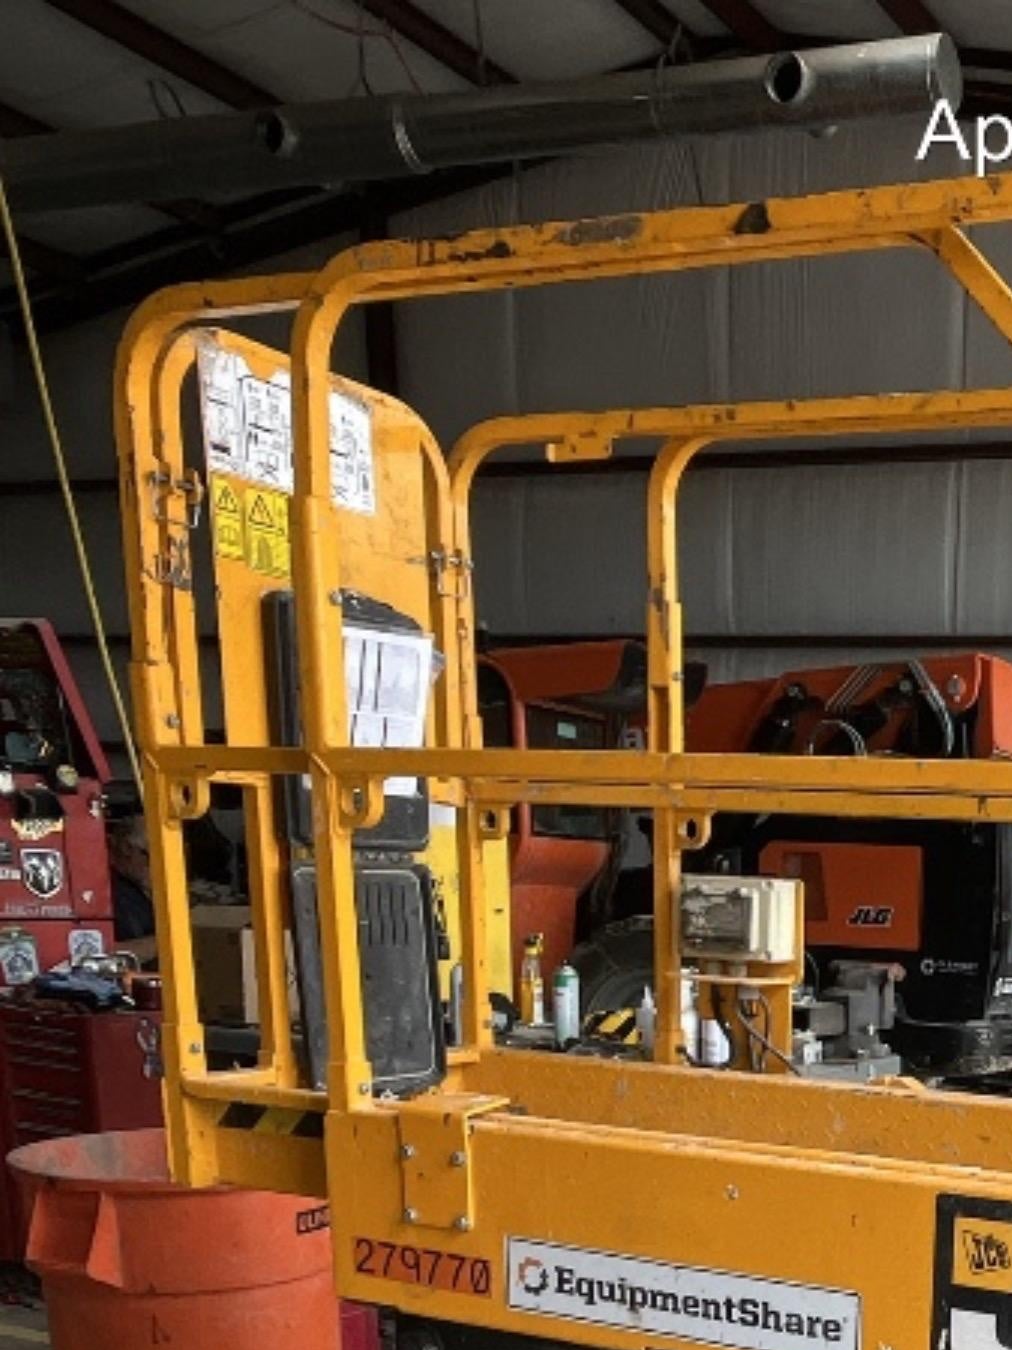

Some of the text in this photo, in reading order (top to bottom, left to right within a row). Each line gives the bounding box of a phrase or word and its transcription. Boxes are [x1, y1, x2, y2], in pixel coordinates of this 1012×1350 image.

[847, 905, 893, 927] JLG
[355, 1238, 490, 1294] 279770
[554, 1265, 843, 1342] EquipmentShare
